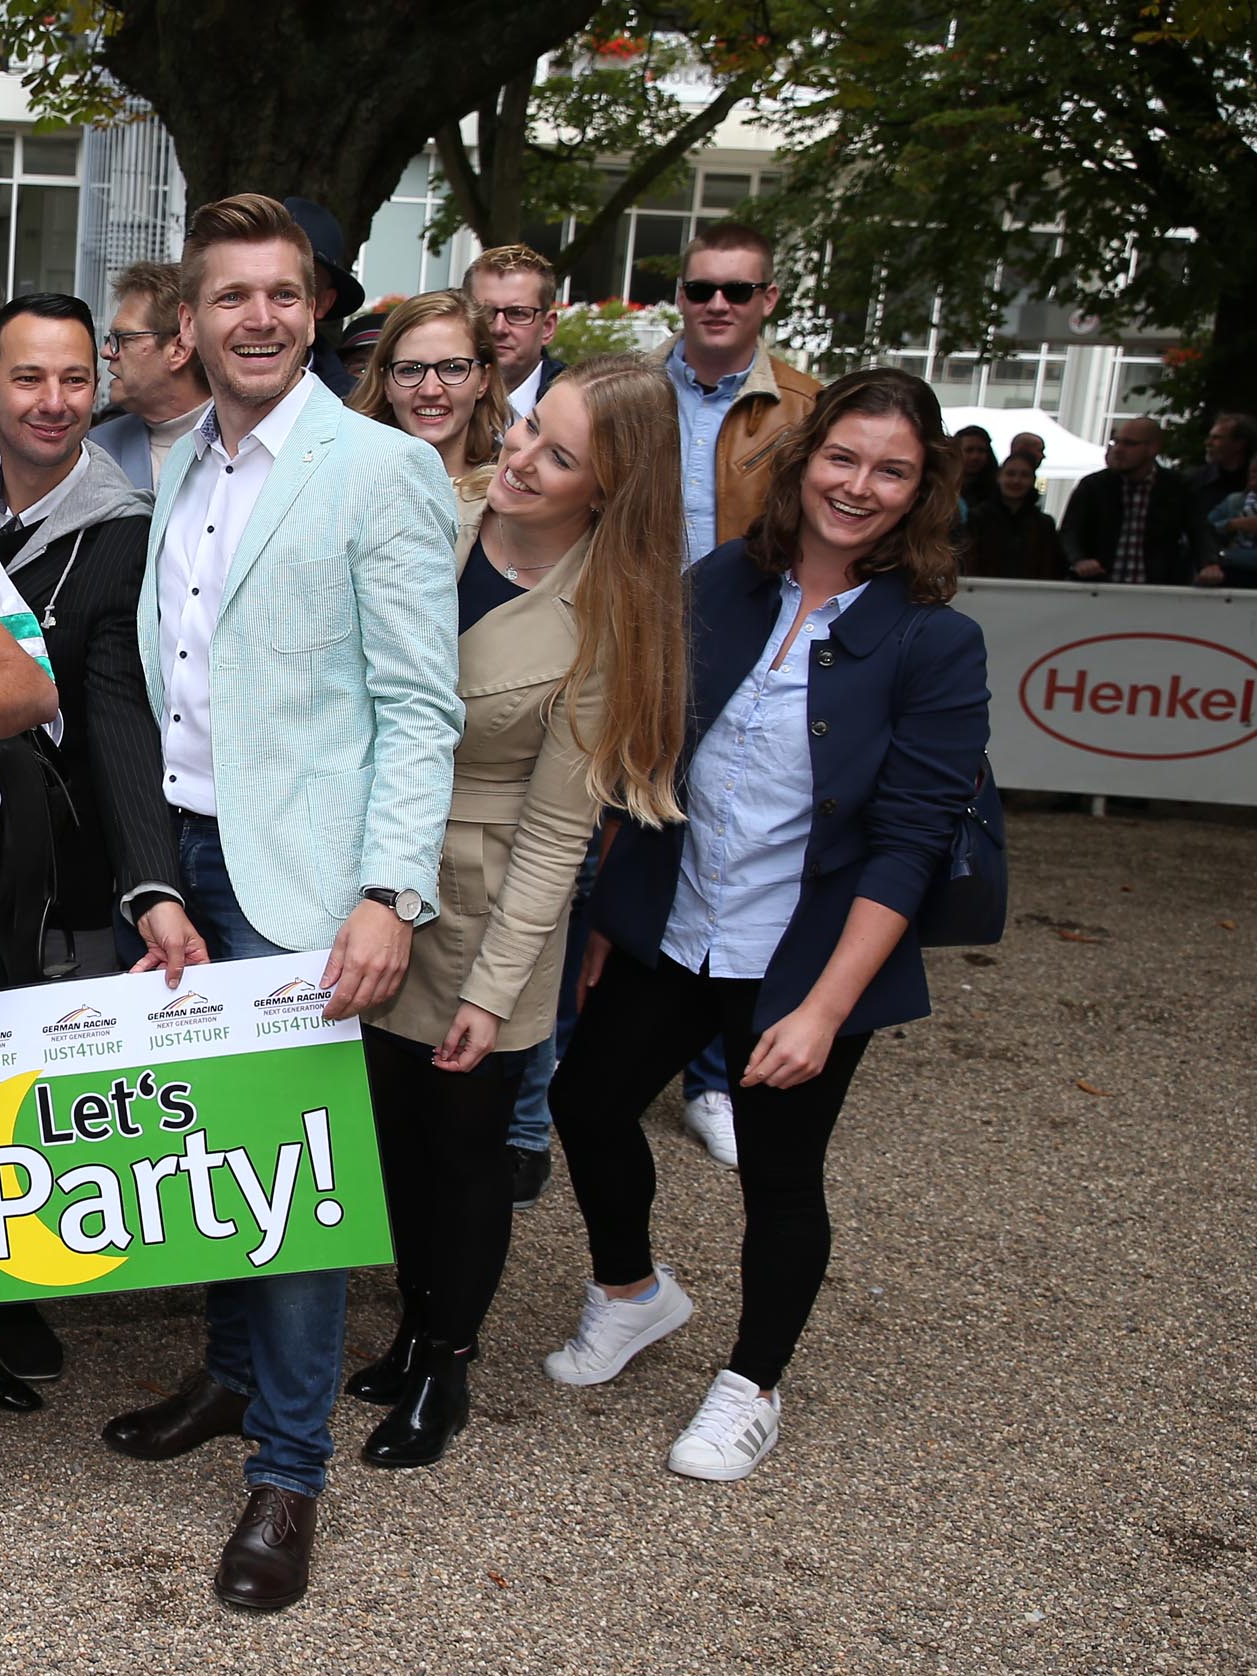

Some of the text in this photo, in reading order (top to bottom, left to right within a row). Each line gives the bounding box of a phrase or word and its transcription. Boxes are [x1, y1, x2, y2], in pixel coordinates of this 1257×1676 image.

[1043, 667, 1256, 725] Henkel
[254, 991, 331, 1008] GERMAN RACING
[147, 1004, 224, 1021] GERMAN RACING
[263, 1003, 325, 1016] NEXT GENERATION
[42, 1018, 117, 1034] GERMAN RACING
[156, 1016, 217, 1029] NEXT GENERATION
[69, 1030, 111, 1040] GENERATION
[149, 1026, 230, 1050] JUST4TURF
[44, 1040, 123, 1064] JUST4TURF
